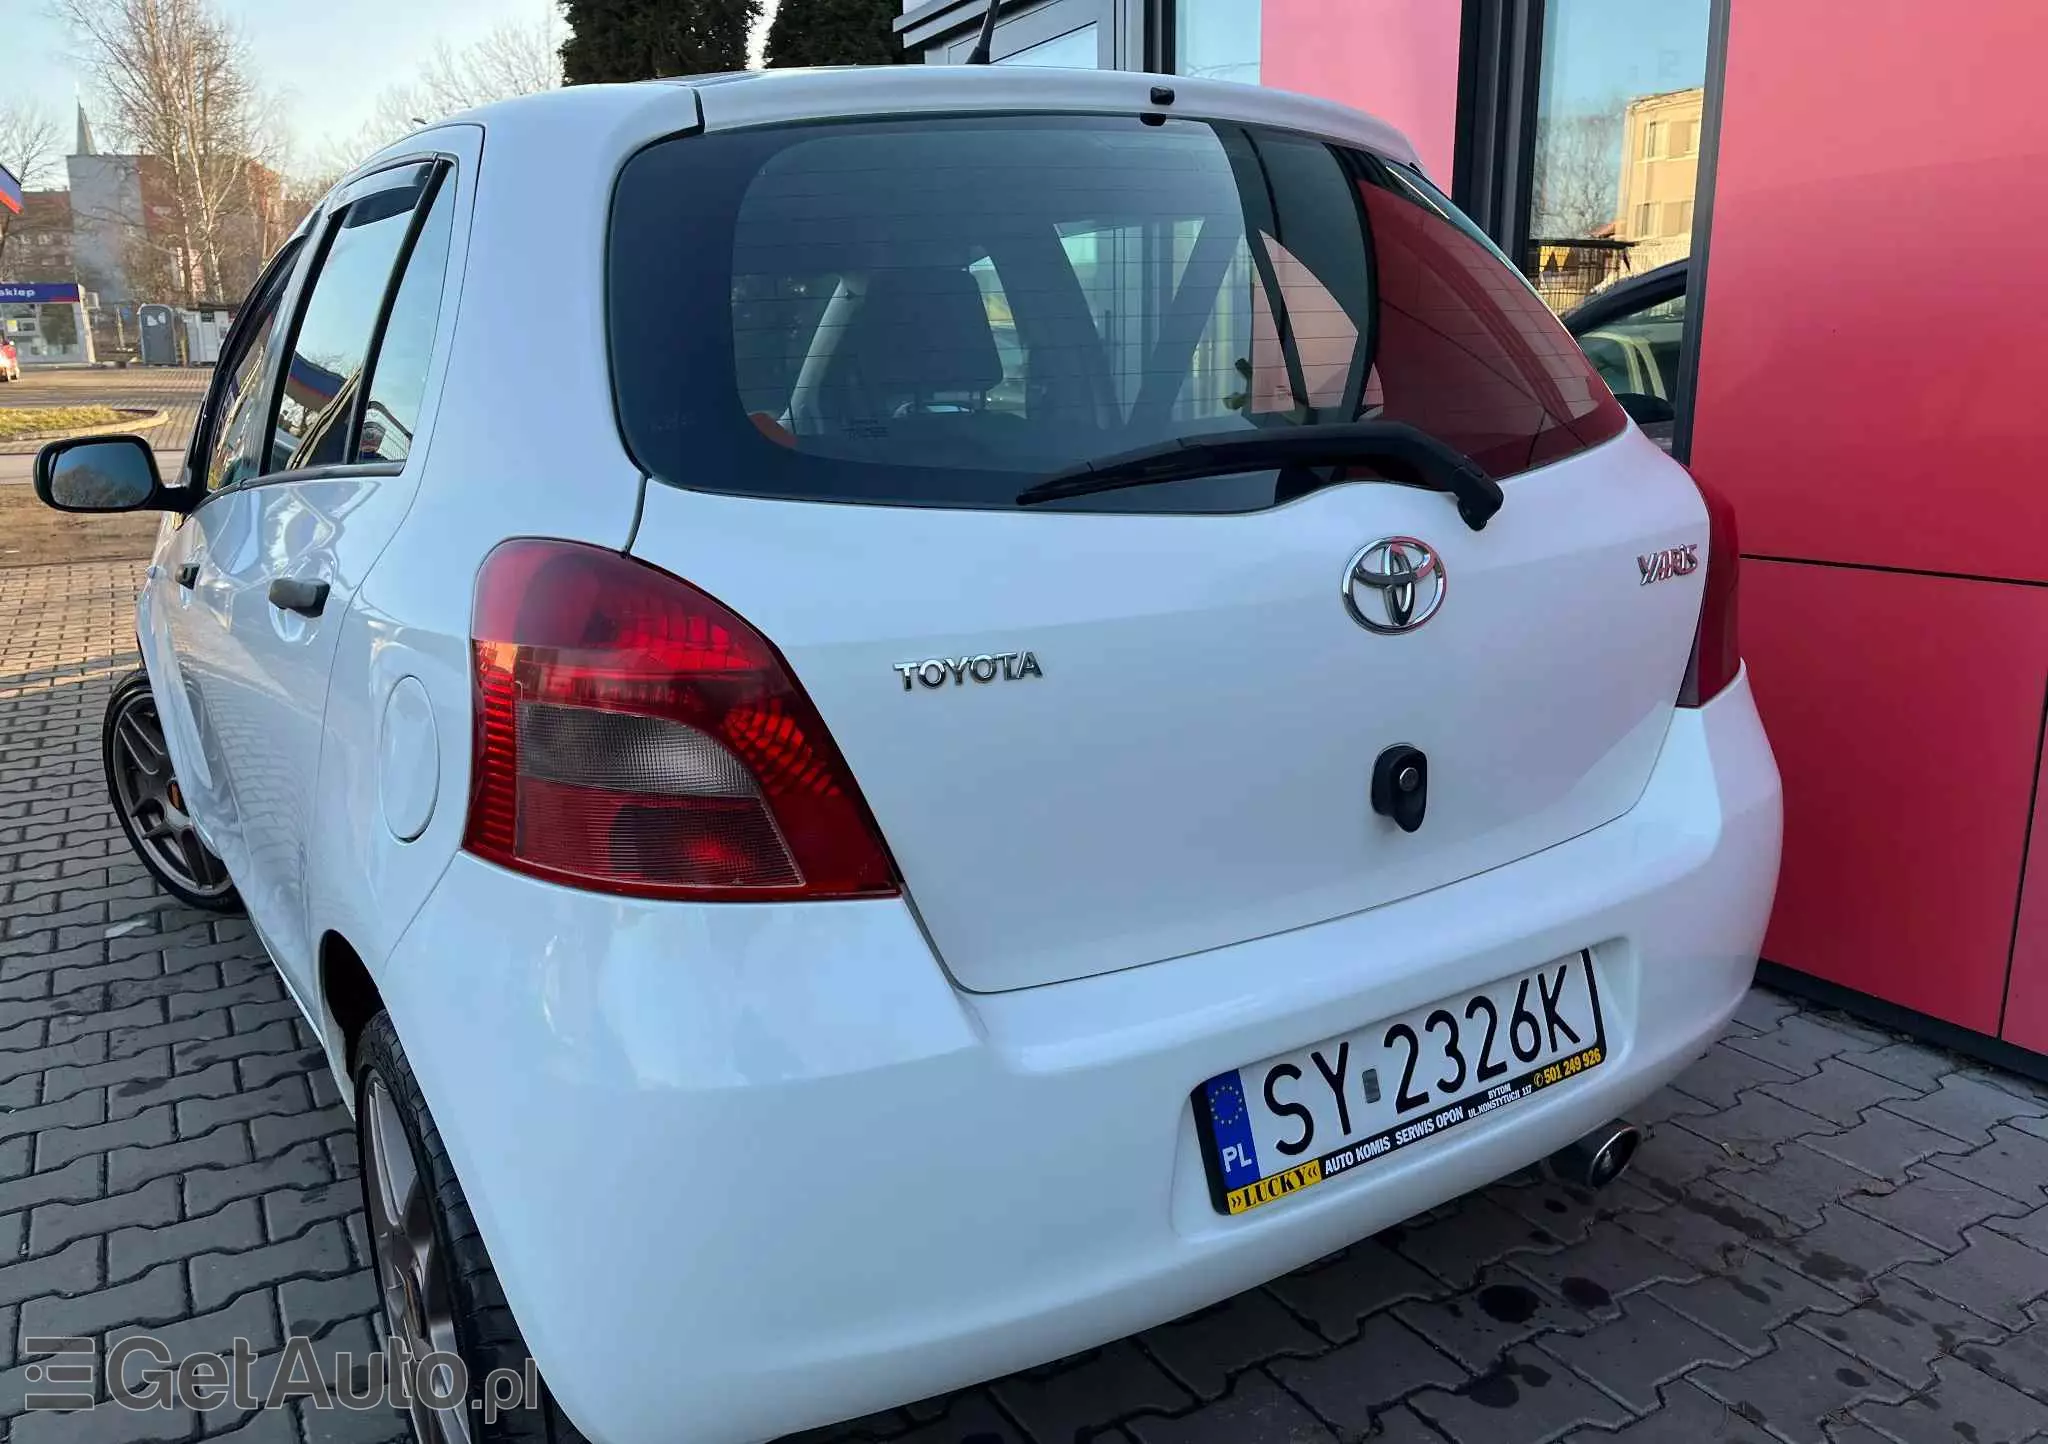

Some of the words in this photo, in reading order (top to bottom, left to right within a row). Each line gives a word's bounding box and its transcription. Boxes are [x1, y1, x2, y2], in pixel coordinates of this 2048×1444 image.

[1637, 544, 1697, 585] YARIS
[893, 651, 1043, 691] TOYOTA
[1263, 1042, 1352, 1156] SY
[1384, 965, 1581, 1114] 2326K
[1543, 1066, 1562, 1084] 501
[1563, 1055, 1582, 1075] 249
[1583, 1048, 1601, 1067] 926
[1487, 1083, 1512, 1100] BYTOM
[1222, 1143, 1252, 1173] PL
[1325, 1152, 1354, 1175] AUTO
[1356, 1135, 1391, 1161] KOMIS
[1395, 1118, 1435, 1146] SERWIS
[1436, 1106, 1464, 1129] OPON
